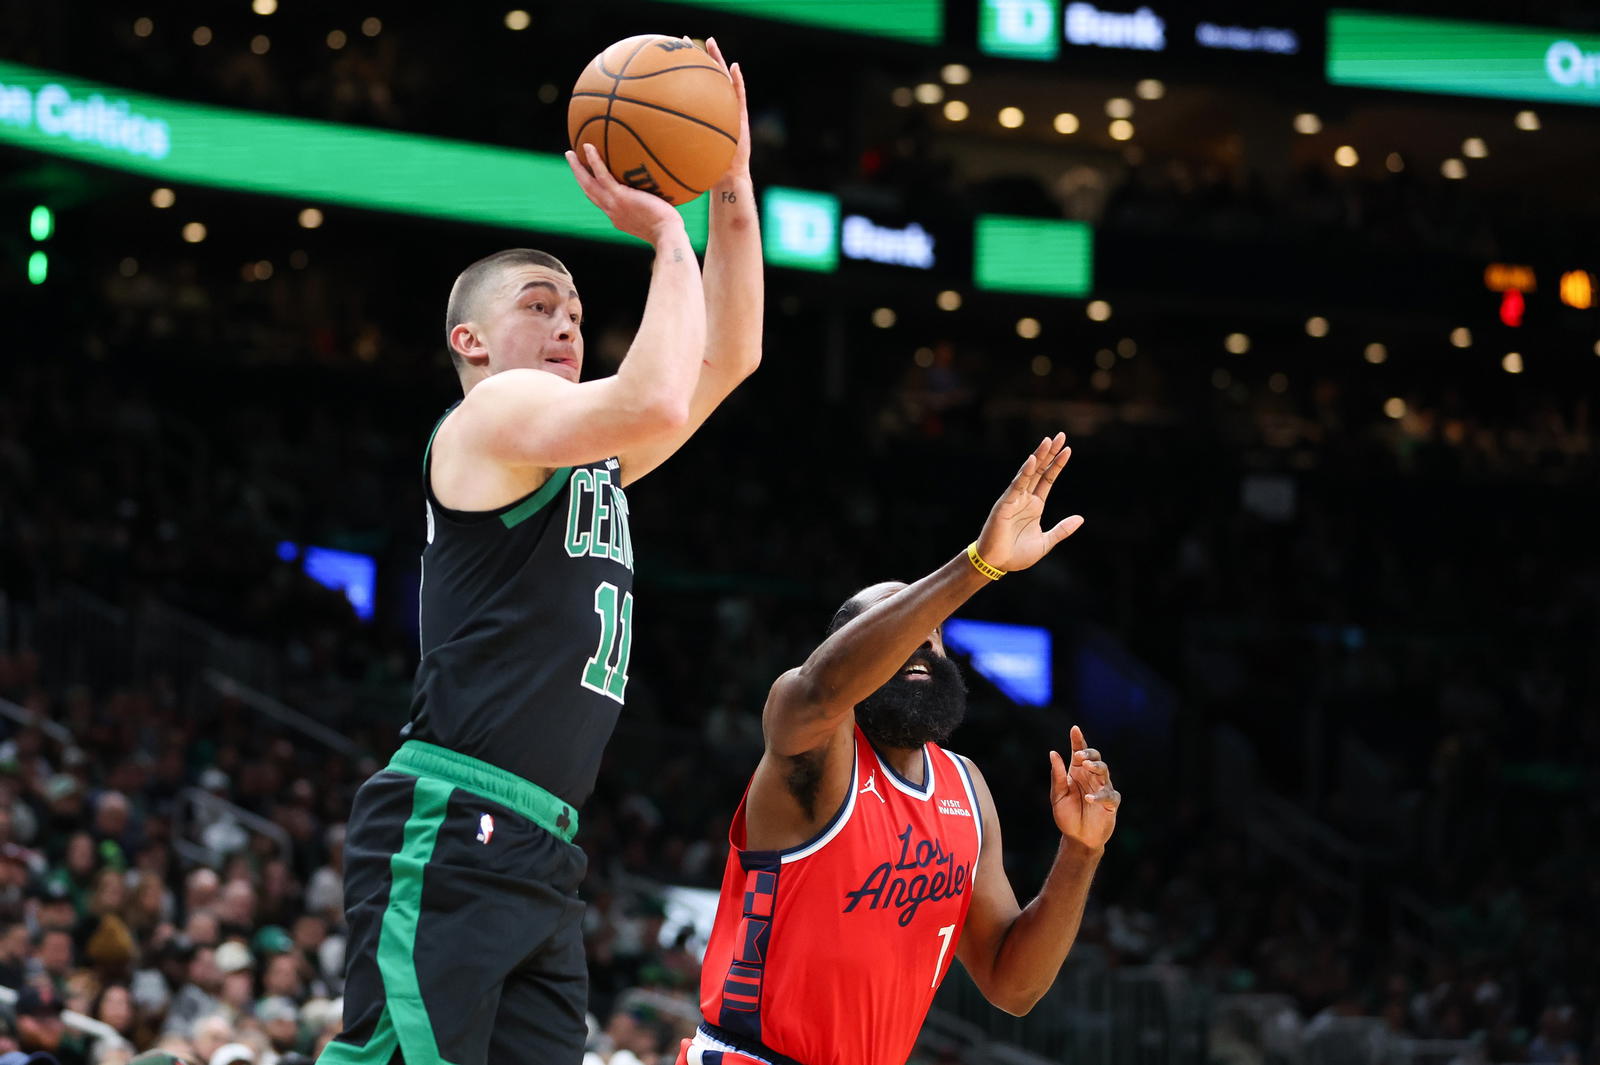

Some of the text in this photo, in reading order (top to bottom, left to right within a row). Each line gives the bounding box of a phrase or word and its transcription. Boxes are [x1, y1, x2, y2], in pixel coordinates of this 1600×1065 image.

[721, 191, 737, 204] F6
[580, 581, 634, 705] 11
[940, 799, 960, 808] VISIT
[895, 823, 950, 871] Los
